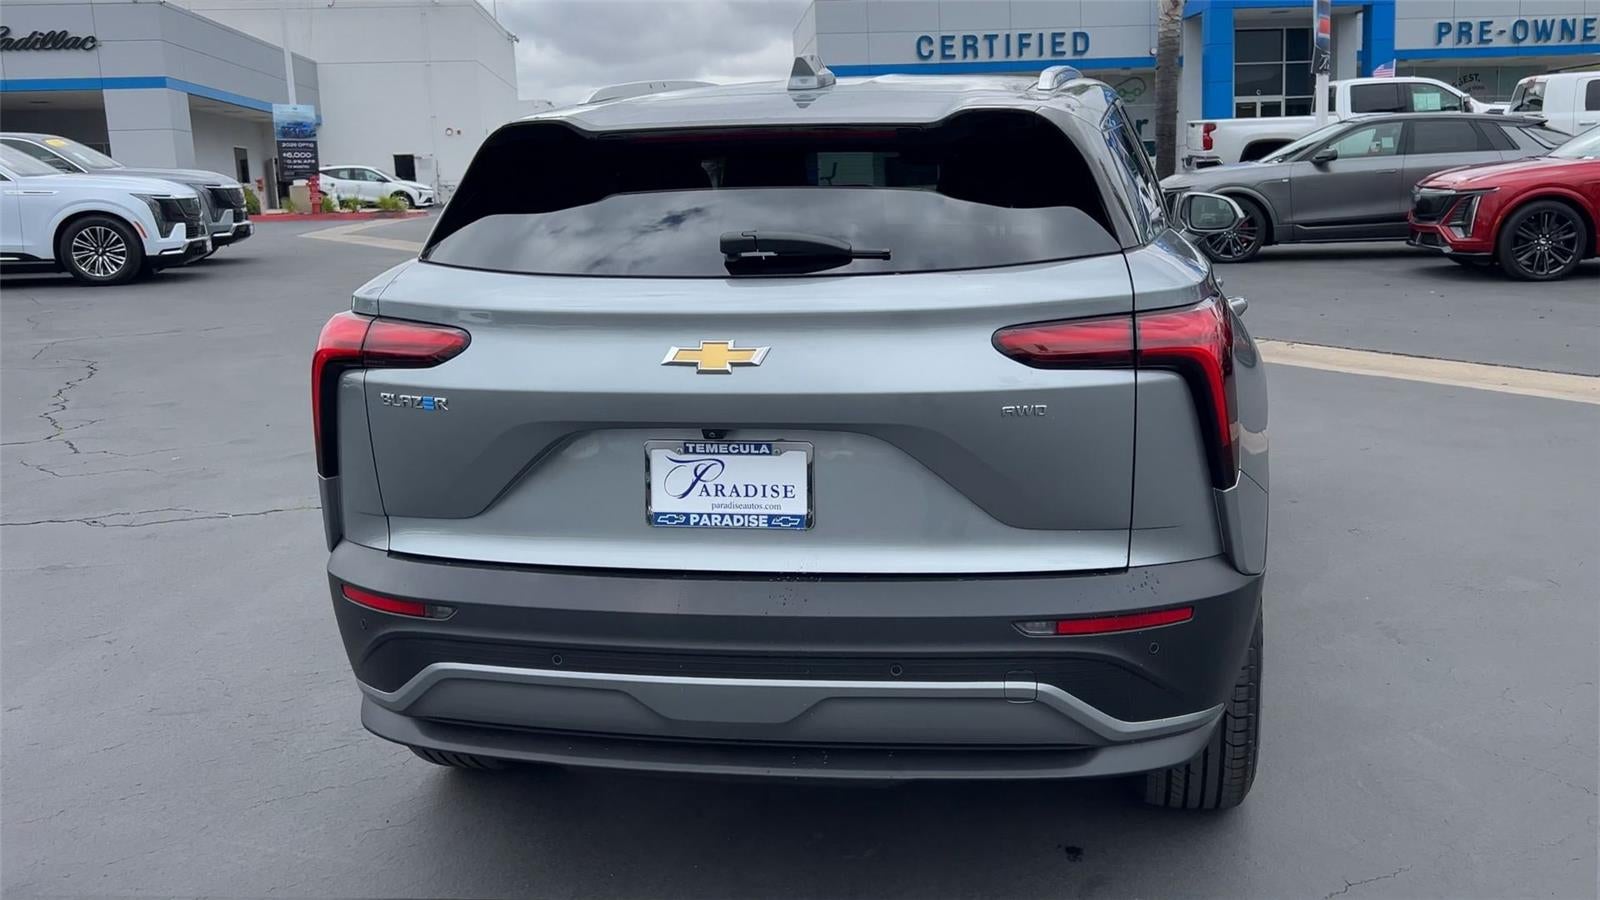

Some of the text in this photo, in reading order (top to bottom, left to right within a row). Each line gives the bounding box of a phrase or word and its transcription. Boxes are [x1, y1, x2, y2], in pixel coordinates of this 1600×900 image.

[1435, 17, 1599, 46] PRE-OWNE
[915, 31, 1091, 61] CERTIFIED
[380, 392, 449, 411] BLAZER
[1001, 404, 1048, 417] AWD
[686, 443, 770, 455] TEMECULA
[663, 455, 796, 500] PARADISE
[711, 501, 782, 511] paradiseautos.com
[689, 513, 769, 528] PARADISE
